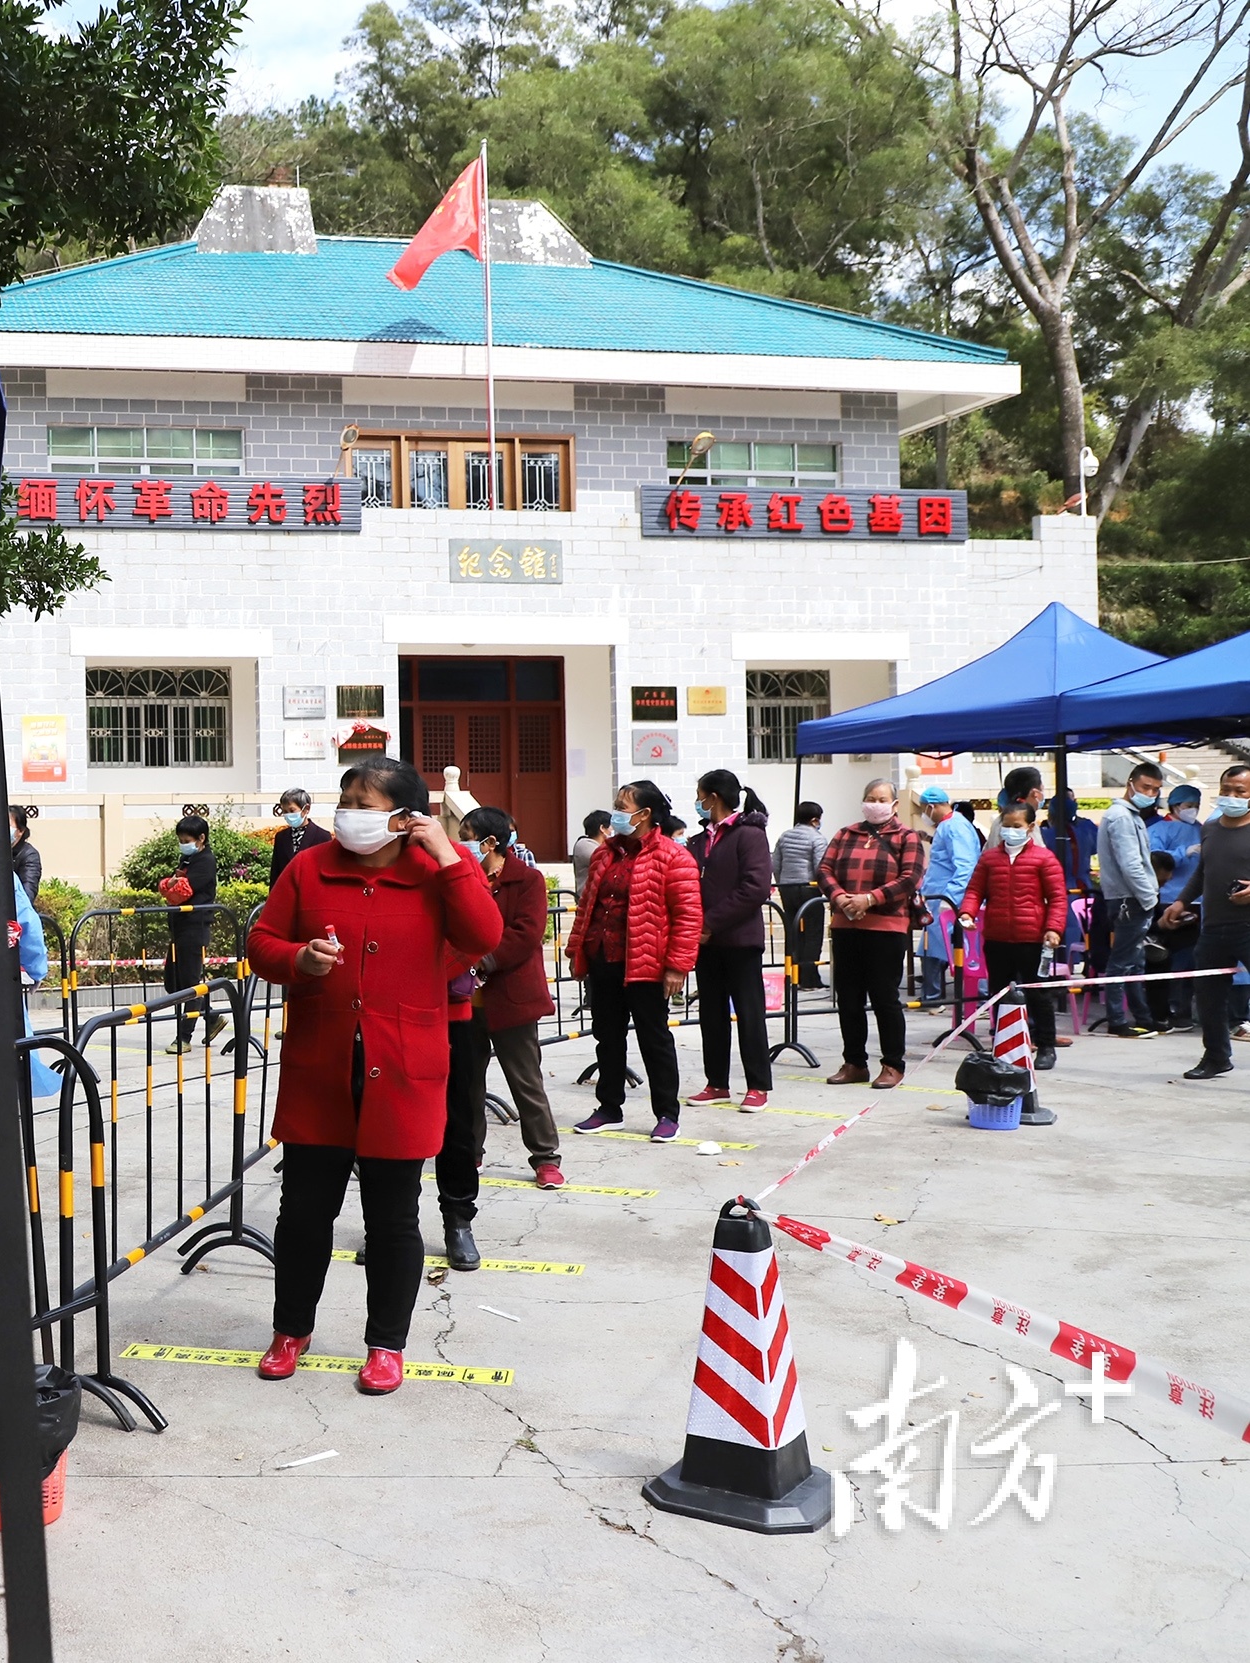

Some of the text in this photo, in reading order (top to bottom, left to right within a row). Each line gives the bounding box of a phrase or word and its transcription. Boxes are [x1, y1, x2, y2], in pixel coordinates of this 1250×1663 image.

[17, 479, 343, 524] 缅怀革命先烈
[665, 490, 951, 534] 传承红色基因
[846, 1250, 882, 1272] 注意
[910, 1273, 948, 1300] 安全
[921, 1269, 955, 1288] SAFE
[991, 1297, 1031, 1319] CAUTION
[991, 1307, 1031, 1336] 注意
[1077, 1332, 1120, 1358] SAFE
[1166, 1371, 1216, 1401] CAUTION
[1168, 1382, 1216, 1420] 注意
